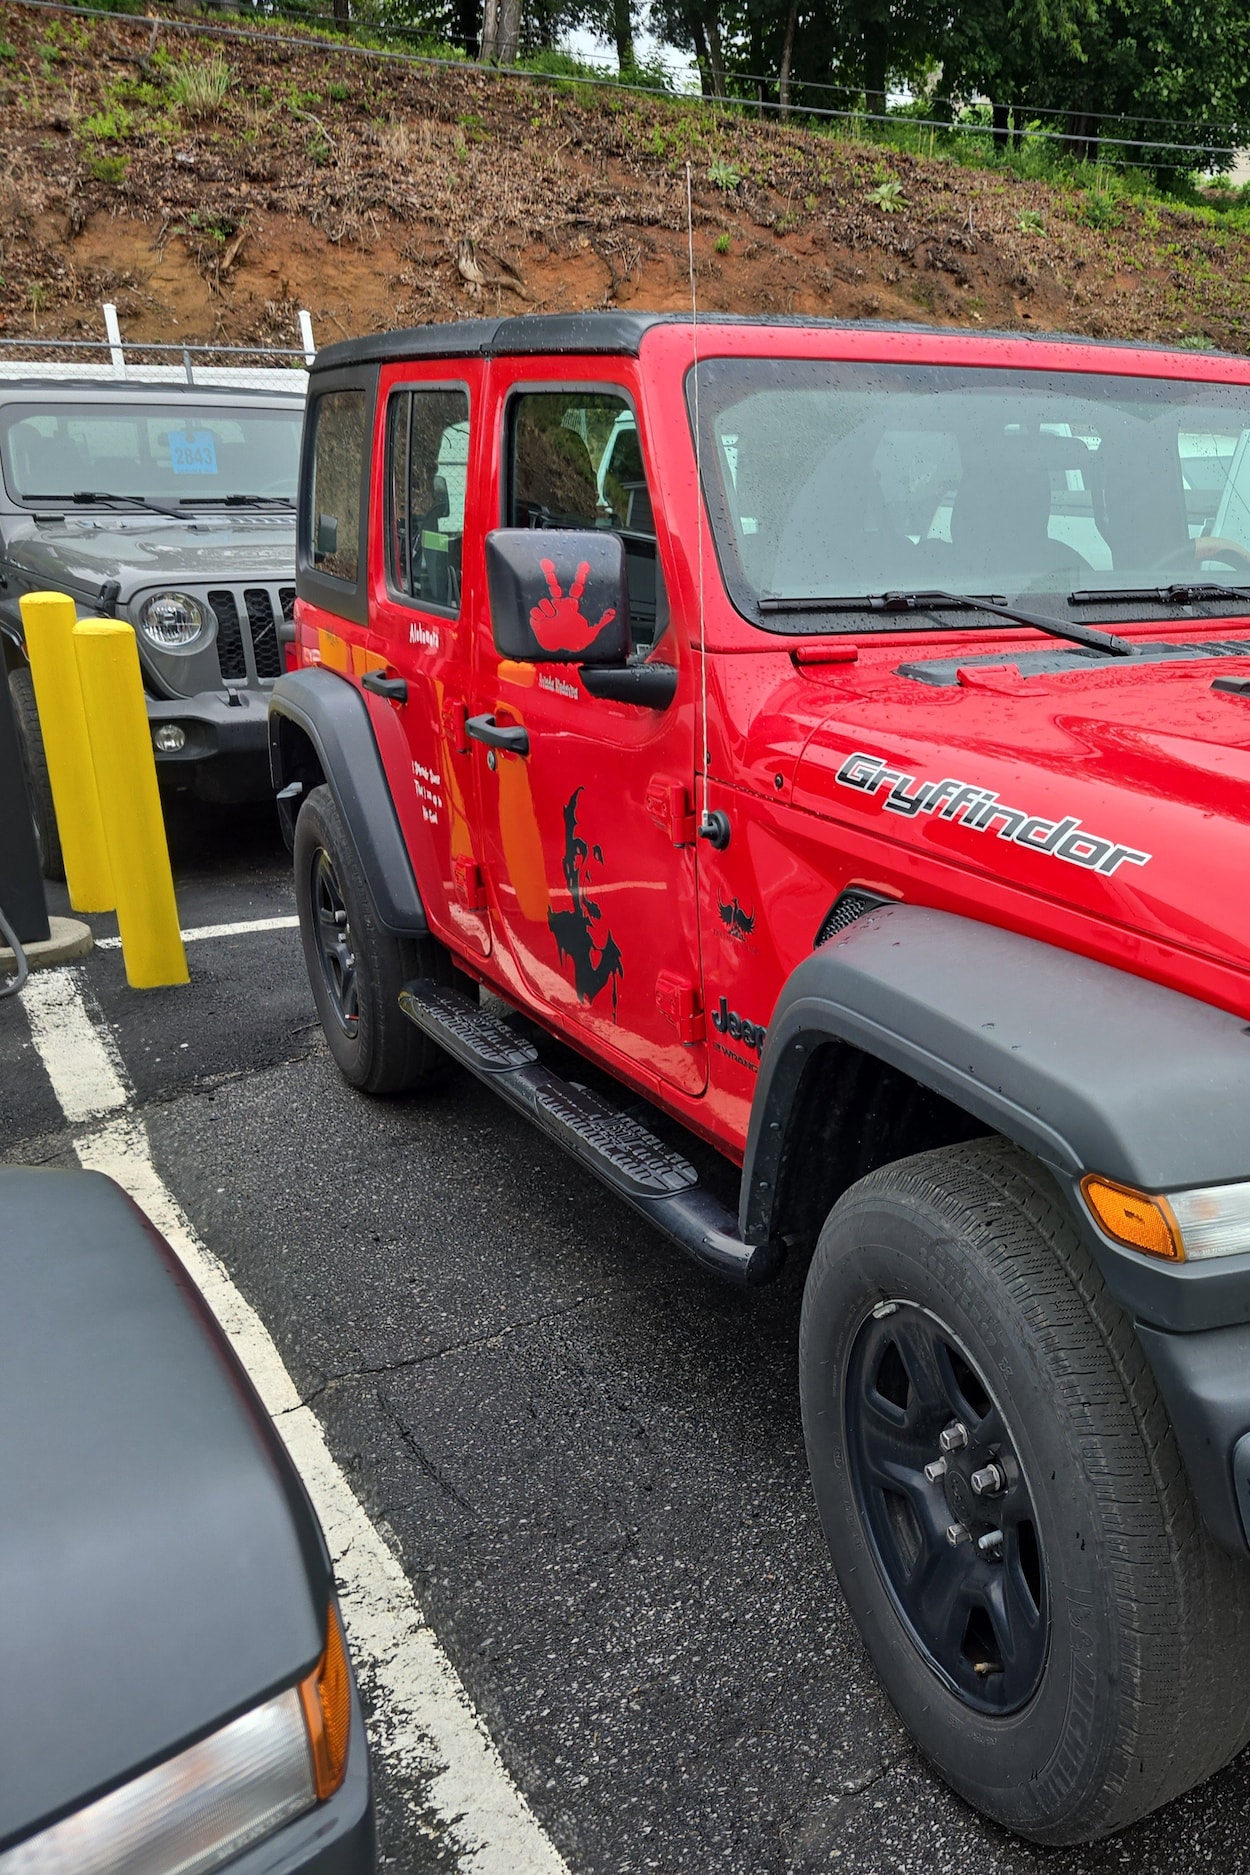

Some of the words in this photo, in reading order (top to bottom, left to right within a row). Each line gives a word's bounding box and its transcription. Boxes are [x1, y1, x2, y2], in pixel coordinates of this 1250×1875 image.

[174, 446, 214, 466] 2843
[834, 751, 1153, 877] Gryffindor
[711, 995, 768, 1061] Jeep
[721, 1045, 760, 1074] WRANG
